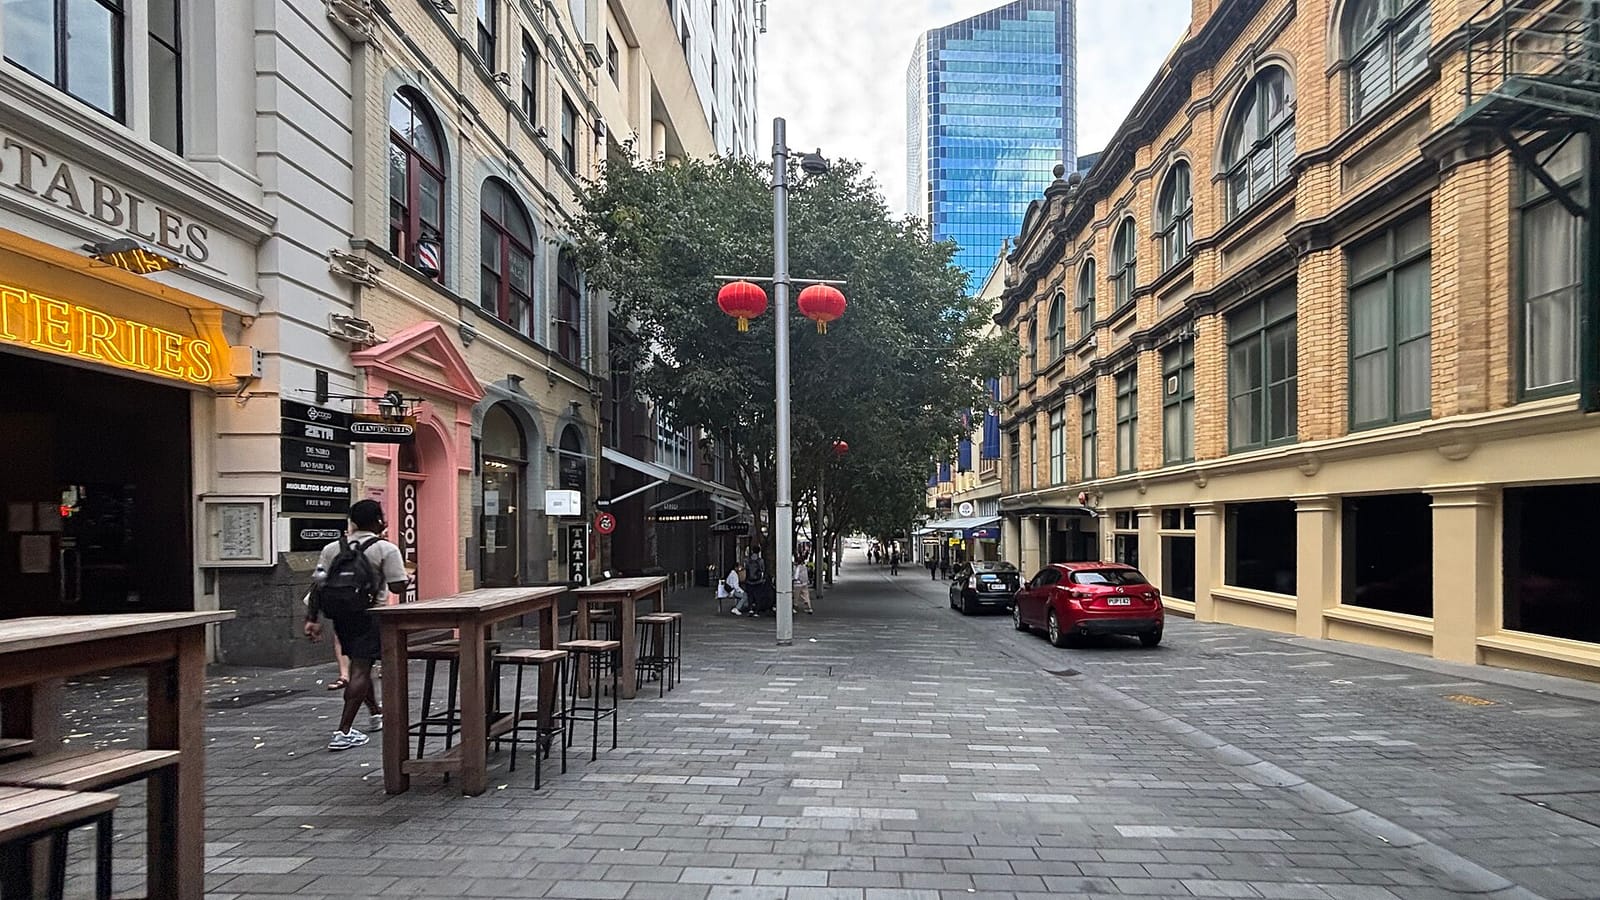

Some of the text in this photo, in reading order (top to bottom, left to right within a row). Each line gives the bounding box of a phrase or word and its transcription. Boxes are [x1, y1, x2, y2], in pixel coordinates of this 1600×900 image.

[0, 137, 209, 263] TABLES
[305, 425, 334, 440] ZETA
[320, 485, 333, 493] SOFT
[305, 499, 319, 507] FREE
[404, 484, 415, 545] COCO
